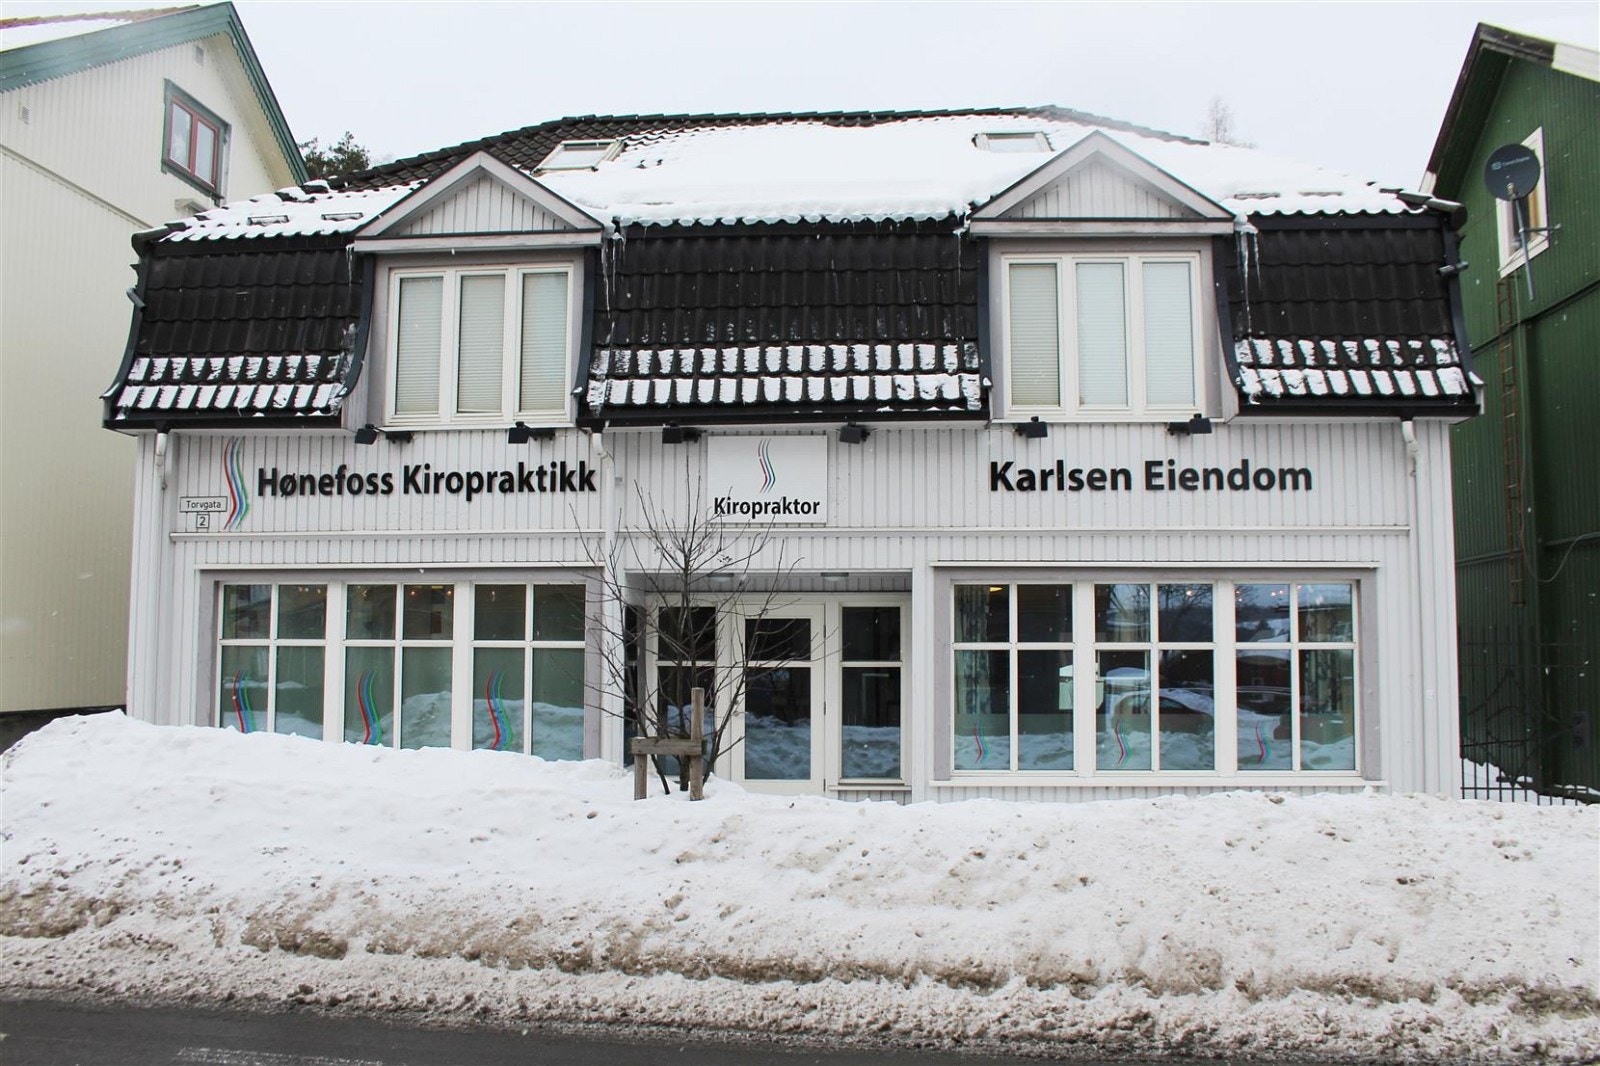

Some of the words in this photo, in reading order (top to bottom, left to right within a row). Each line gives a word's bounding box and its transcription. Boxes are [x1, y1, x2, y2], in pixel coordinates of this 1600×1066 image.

[258, 463, 393, 498] Hønefoss
[403, 461, 597, 502] Kiropraktikk
[990, 459, 1132, 492] Karlsen
[1144, 458, 1312, 492] Eiendom
[186, 500, 222, 510] Torvgata
[714, 497, 820, 519] Kiropraktor
[199, 516, 206, 526] 2
